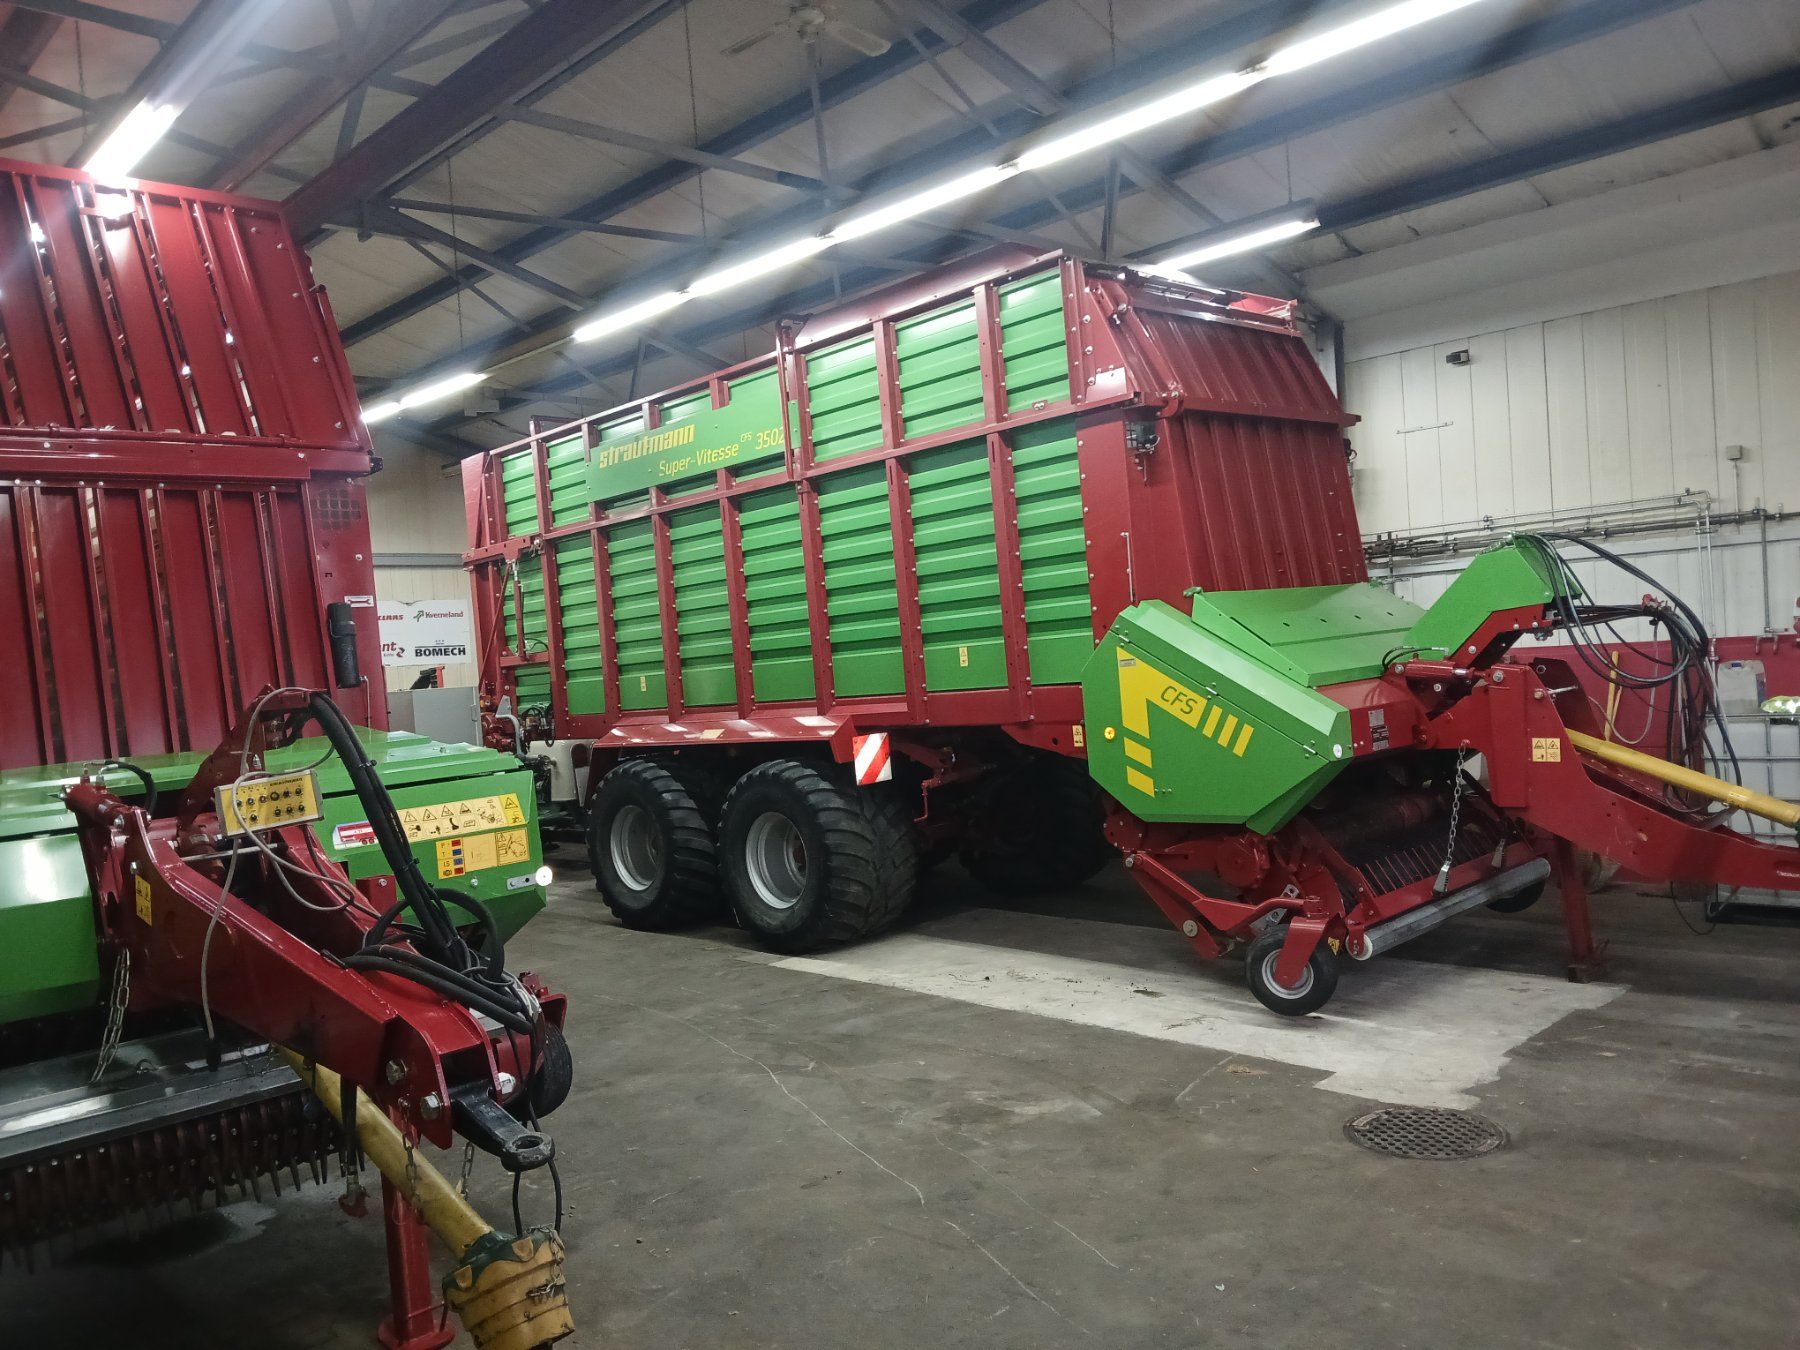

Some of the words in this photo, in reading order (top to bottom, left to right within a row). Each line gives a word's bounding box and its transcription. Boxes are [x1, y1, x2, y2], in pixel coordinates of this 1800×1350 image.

[600, 424, 695, 469] strautmann
[658, 442, 739, 477] Super-Vitesse
[425, 610, 464, 619] Kverneland
[382, 641, 396, 652] nt
[415, 647, 466, 657] BOMECH
[1160, 685, 1198, 715] CFS
